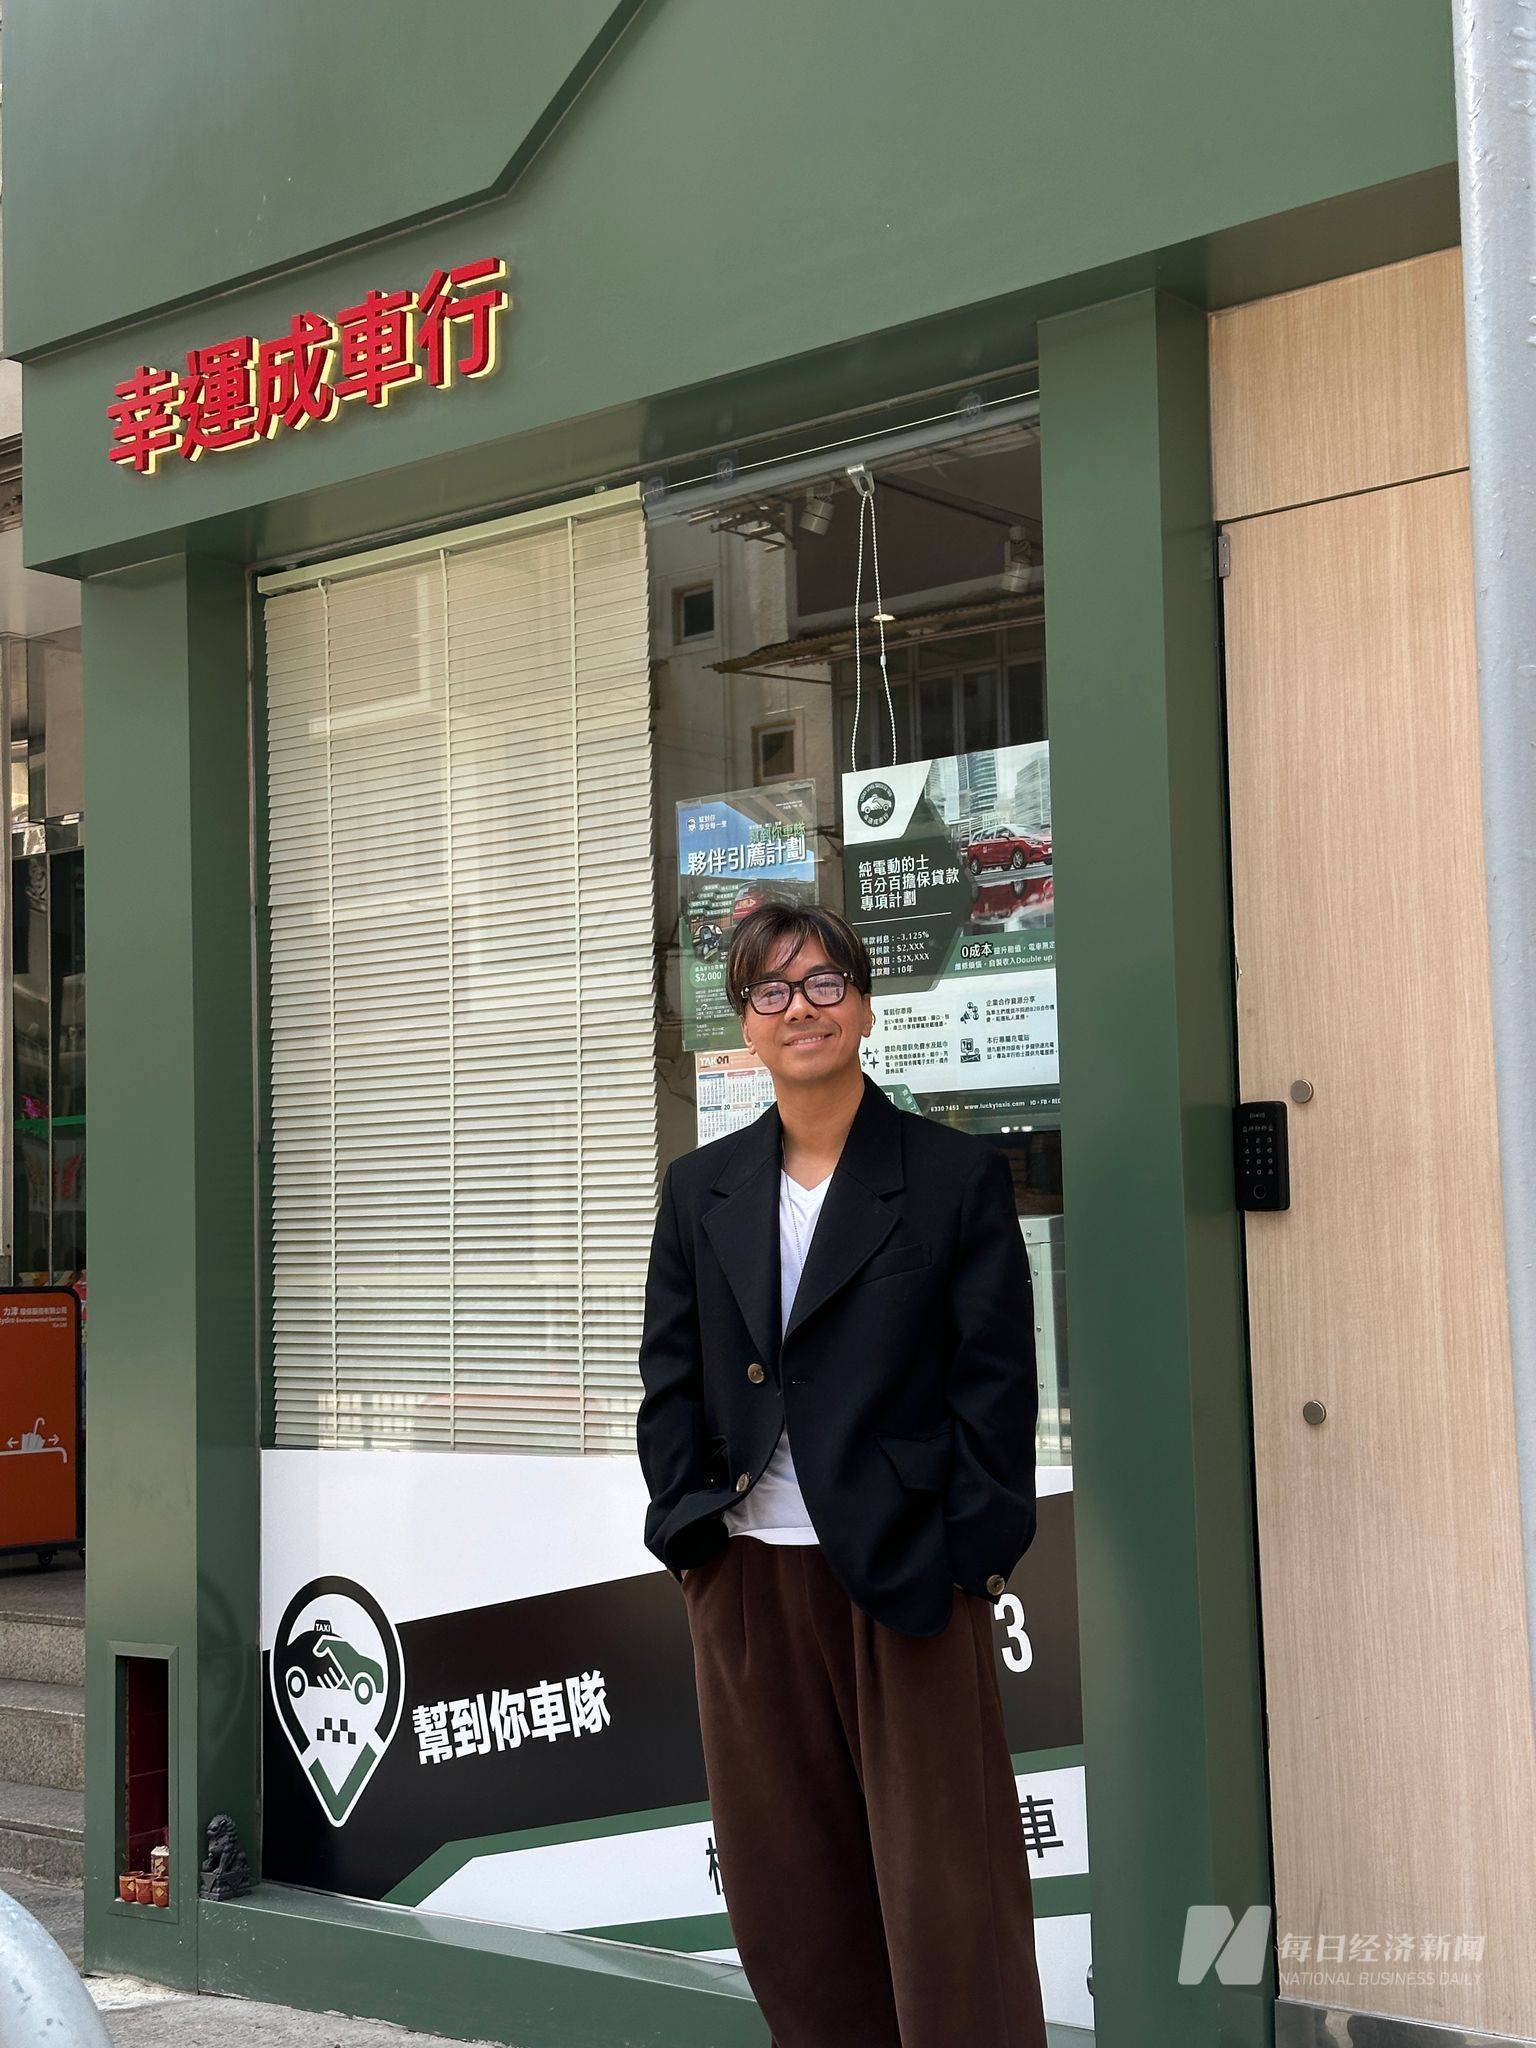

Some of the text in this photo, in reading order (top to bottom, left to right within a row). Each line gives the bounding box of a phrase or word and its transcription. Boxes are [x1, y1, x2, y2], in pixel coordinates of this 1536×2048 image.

[107, 258, 509, 474] 幸運成車行
[687, 835, 806, 876] 夥伴引薦計劃
[858, 854, 930, 878] 純電動的士
[860, 867, 960, 895] 百分百擔保貸款
[860, 889, 917, 911] 專項計劃
[695, 971, 722, 983] $2,000
[315, 1623, 331, 1632] TAXI
[411, 1670, 612, 1766] 幫到你車隊
